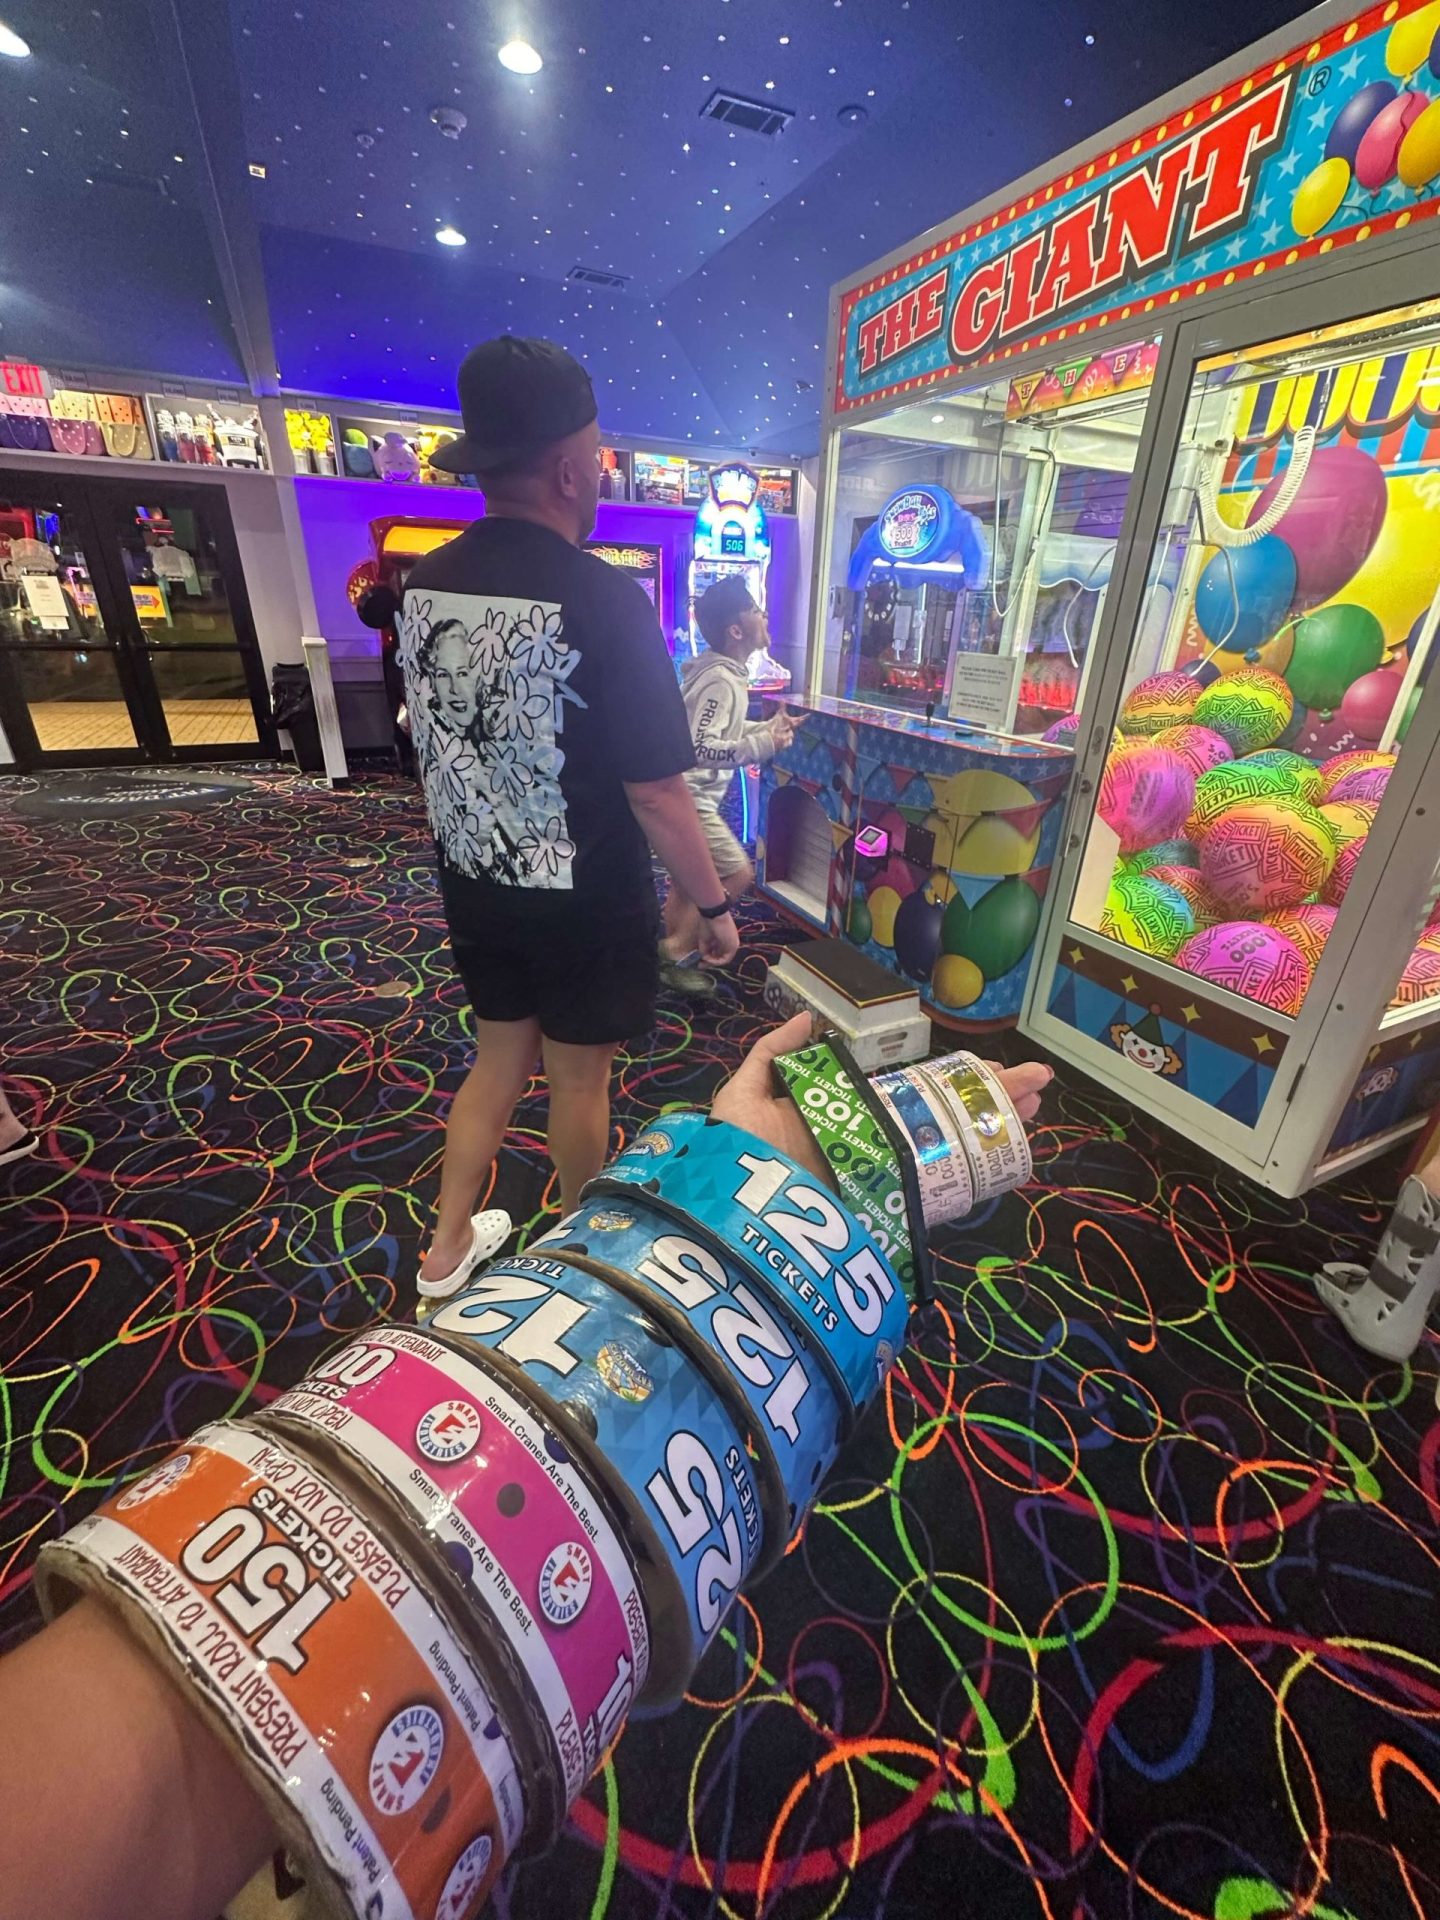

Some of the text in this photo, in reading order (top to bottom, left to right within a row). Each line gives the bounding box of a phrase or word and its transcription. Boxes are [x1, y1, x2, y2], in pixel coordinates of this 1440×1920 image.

[858, 73, 1291, 374] THE GIANT
[0, 361, 45, 396] EXIT
[725, 539, 744, 551] 506
[698, 745, 736, 762] ROCK
[1206, 781, 1248, 811] TICKET
[1267, 838, 1280, 874] TICKET
[1290, 841, 1314, 867] TICKET
[1244, 969, 1265, 997] CKET
[804, 1087, 865, 1131] 100
[813, 1076, 852, 1103] TICKETS
[800, 1104, 839, 1133] TICKETS
[826, 1142, 887, 1193] 100
[841, 1131, 884, 1161] TICKETS
[862, 1199, 895, 1232] TICKETS
[732, 1151, 896, 1337] 125
[740, 1223, 839, 1332] TICKETS
[390, 1331, 447, 1362] ATTENDANT
[429, 1273, 592, 1380] 12
[636, 1234, 811, 1447] 125
[314, 1344, 398, 1386] 00
[311, 1402, 353, 1430] OPEN
[419, 1414, 467, 1458] INDUSTRIES
[448, 1401, 479, 1430] SMART
[485, 1396, 600, 1544] Smart Cranes Are The Best.
[286, 1475, 329, 1512] NOT
[250, 1485, 358, 1601] TICKETS
[319, 1505, 354, 1539] DO
[645, 1429, 742, 1634] 25
[113, 1543, 191, 1608] ATTENDANT
[343, 1530, 411, 1610] PLEASE
[446, 1509, 477, 1549] ranes
[474, 1546, 495, 1573] Are
[492, 1568, 513, 1600] The
[508, 1594, 533, 1637] Best.
[566, 1543, 592, 1584] SMART
[179, 1504, 336, 1677] 150
[541, 1557, 579, 1621] INDUSTRIES
[175, 1601, 208, 1632] TO
[195, 1621, 247, 1683] ROLL
[428, 1640, 481, 1732] Patent Pending
[230, 1669, 309, 1770] PRESENT
[391, 1708, 443, 1786] INDUSTRIES
[371, 1761, 404, 1812] SMART
[319, 1776, 382, 1884] Patent Pending
